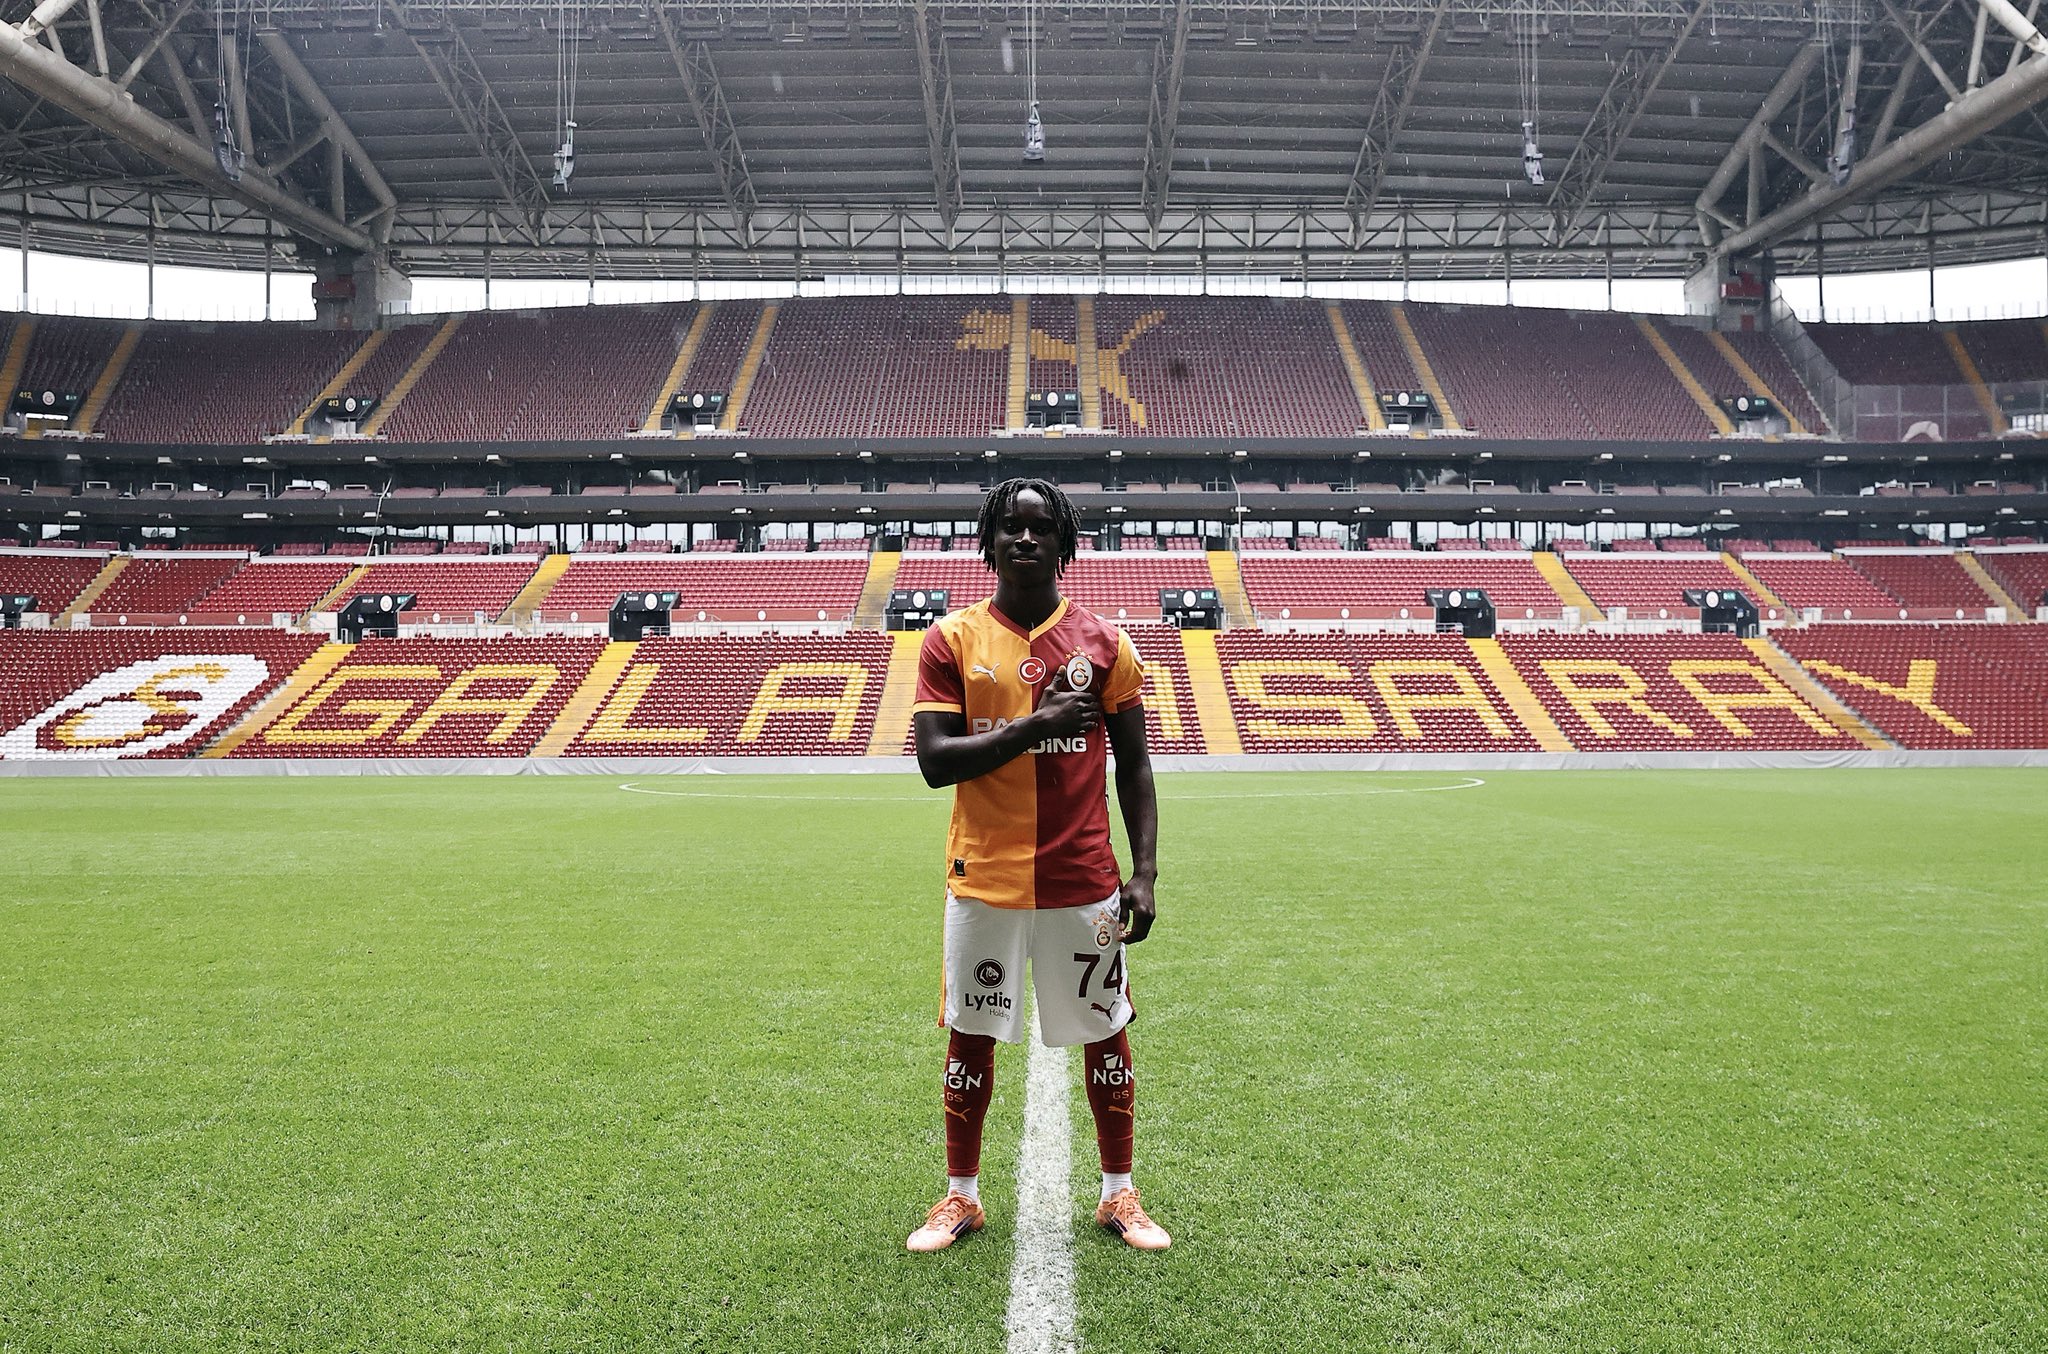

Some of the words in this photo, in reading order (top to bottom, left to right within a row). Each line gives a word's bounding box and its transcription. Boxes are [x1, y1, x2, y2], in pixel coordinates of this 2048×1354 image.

[19, 391, 32, 399] 412
[263, 659, 1973, 743] GALASARAY
[1074, 949, 1123, 998] 74
[965, 992, 1011, 1011] Lydia
[1093, 1063, 1134, 1085] NGN
[946, 1091, 963, 1103] GS
[1112, 1089, 1130, 1100] GS
